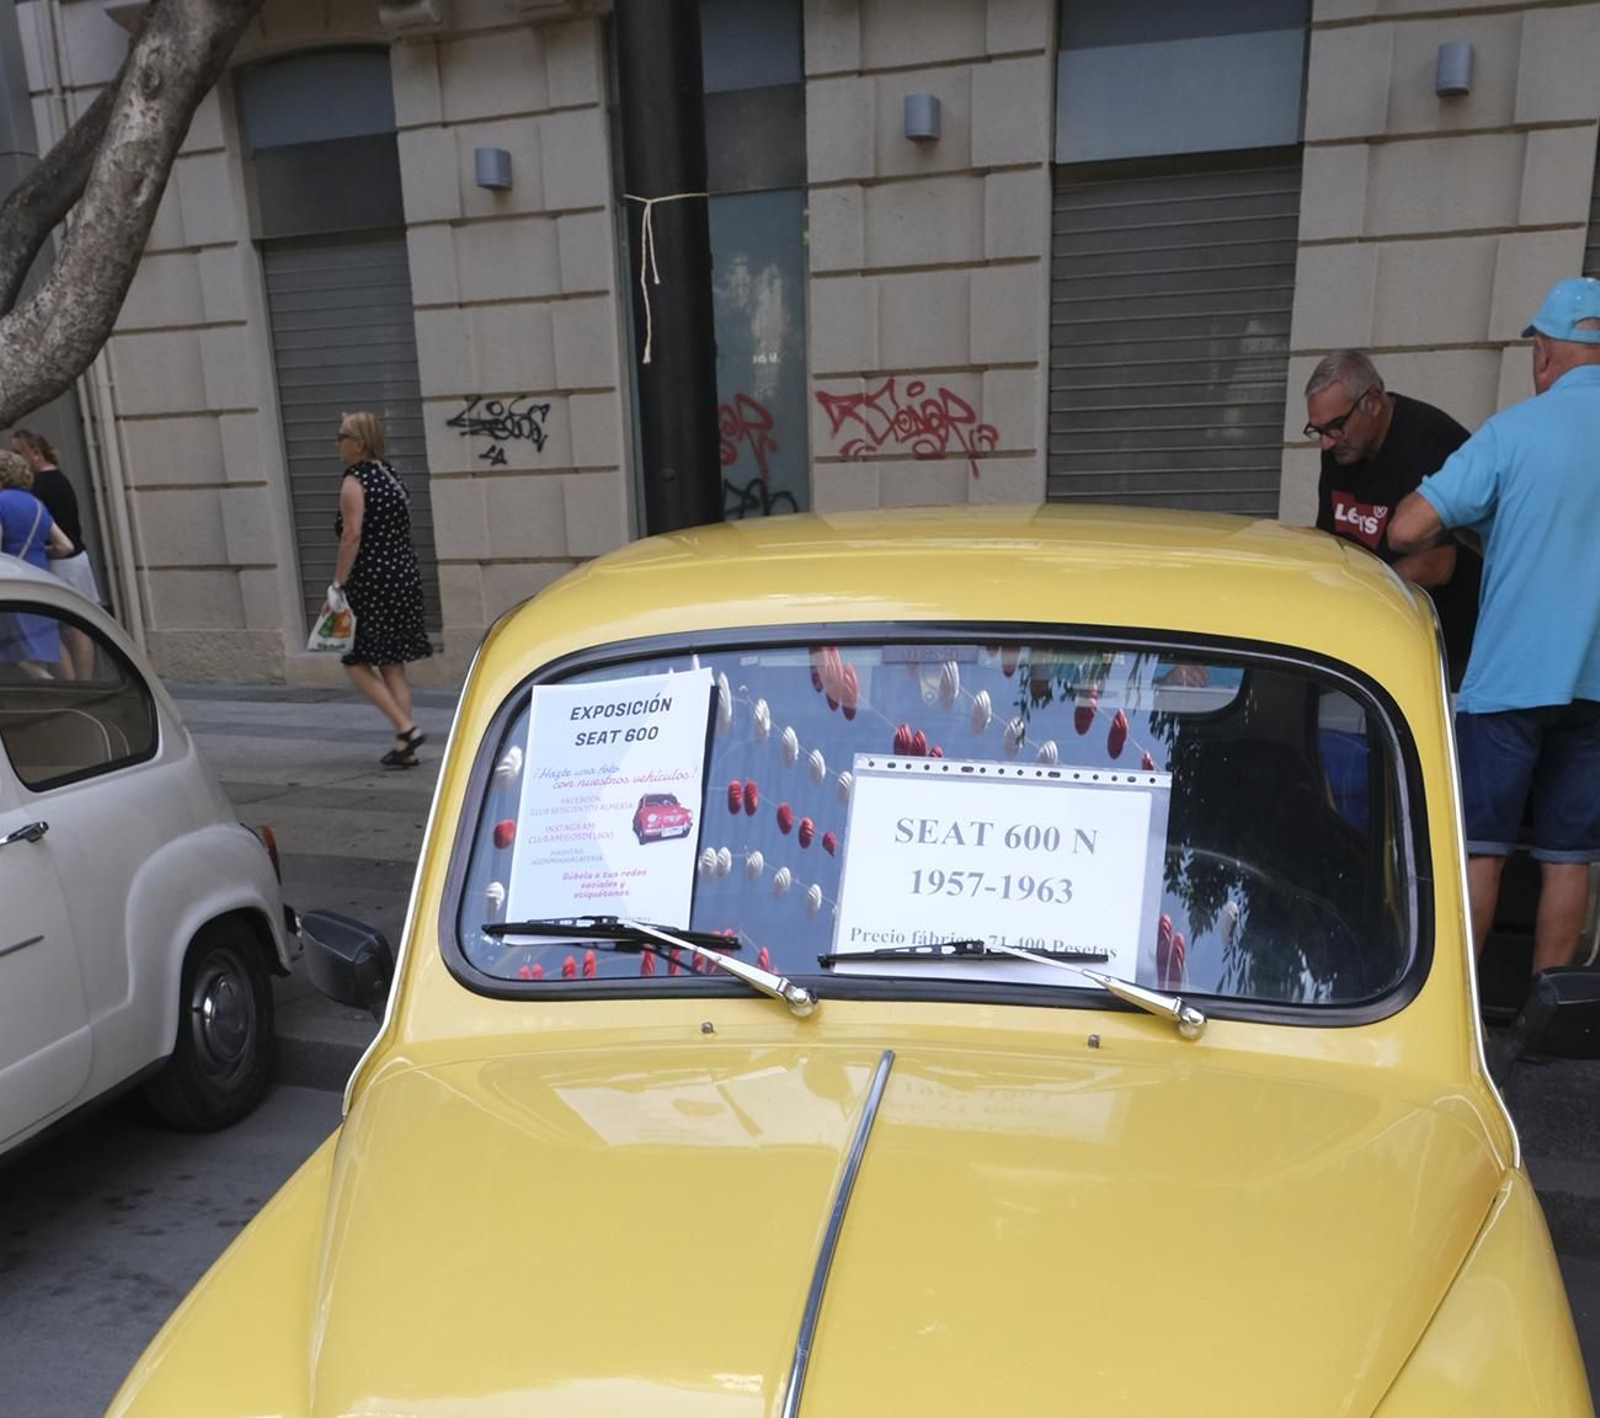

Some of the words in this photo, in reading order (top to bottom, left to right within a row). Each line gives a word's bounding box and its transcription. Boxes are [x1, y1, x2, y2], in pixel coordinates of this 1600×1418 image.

[570, 692, 673, 721] EXPOSICIÓN
[574, 730, 622, 746] SEAT
[624, 726, 659, 742] 600
[895, 817, 994, 847] SEAT
[1004, 824, 1061, 852] 600
[1073, 828, 1099, 855] N
[910, 868, 1073, 904] 1957-1963
[851, 927, 906, 944] Precio
